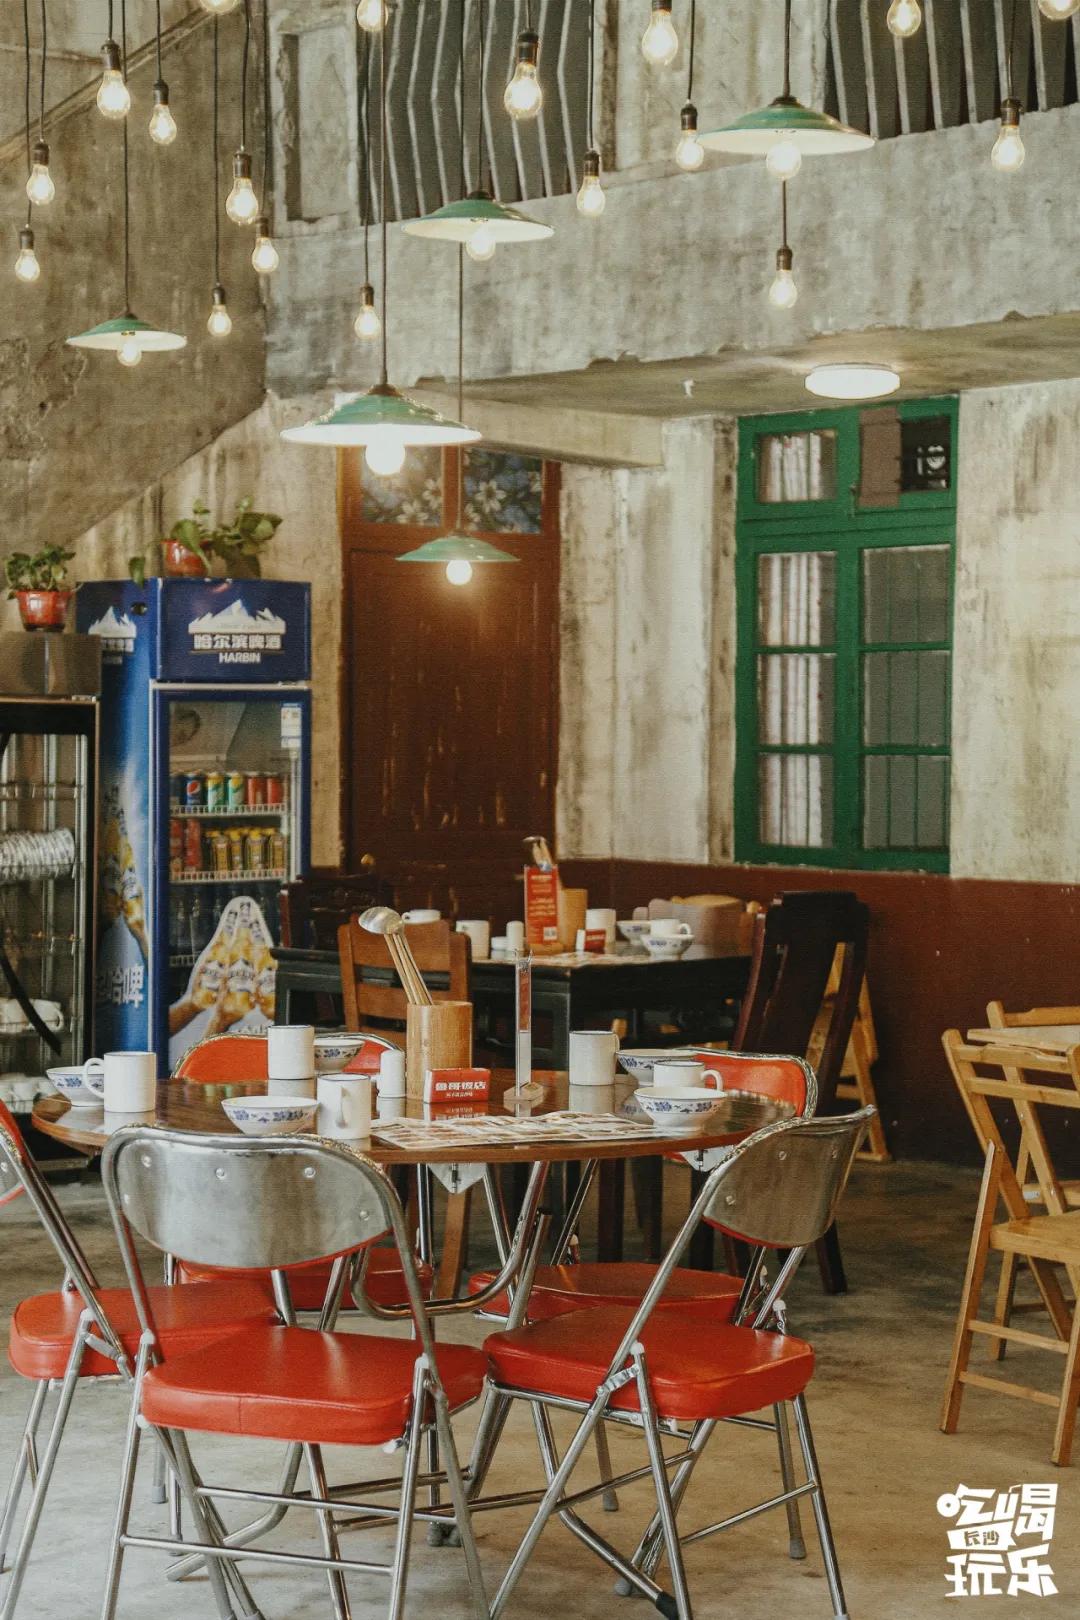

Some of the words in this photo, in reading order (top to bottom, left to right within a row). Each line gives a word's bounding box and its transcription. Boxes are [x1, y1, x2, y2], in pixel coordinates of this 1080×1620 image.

[193, 634, 282, 650] 哈尔滨啤酒
[218, 652, 261, 664] HARBIN
